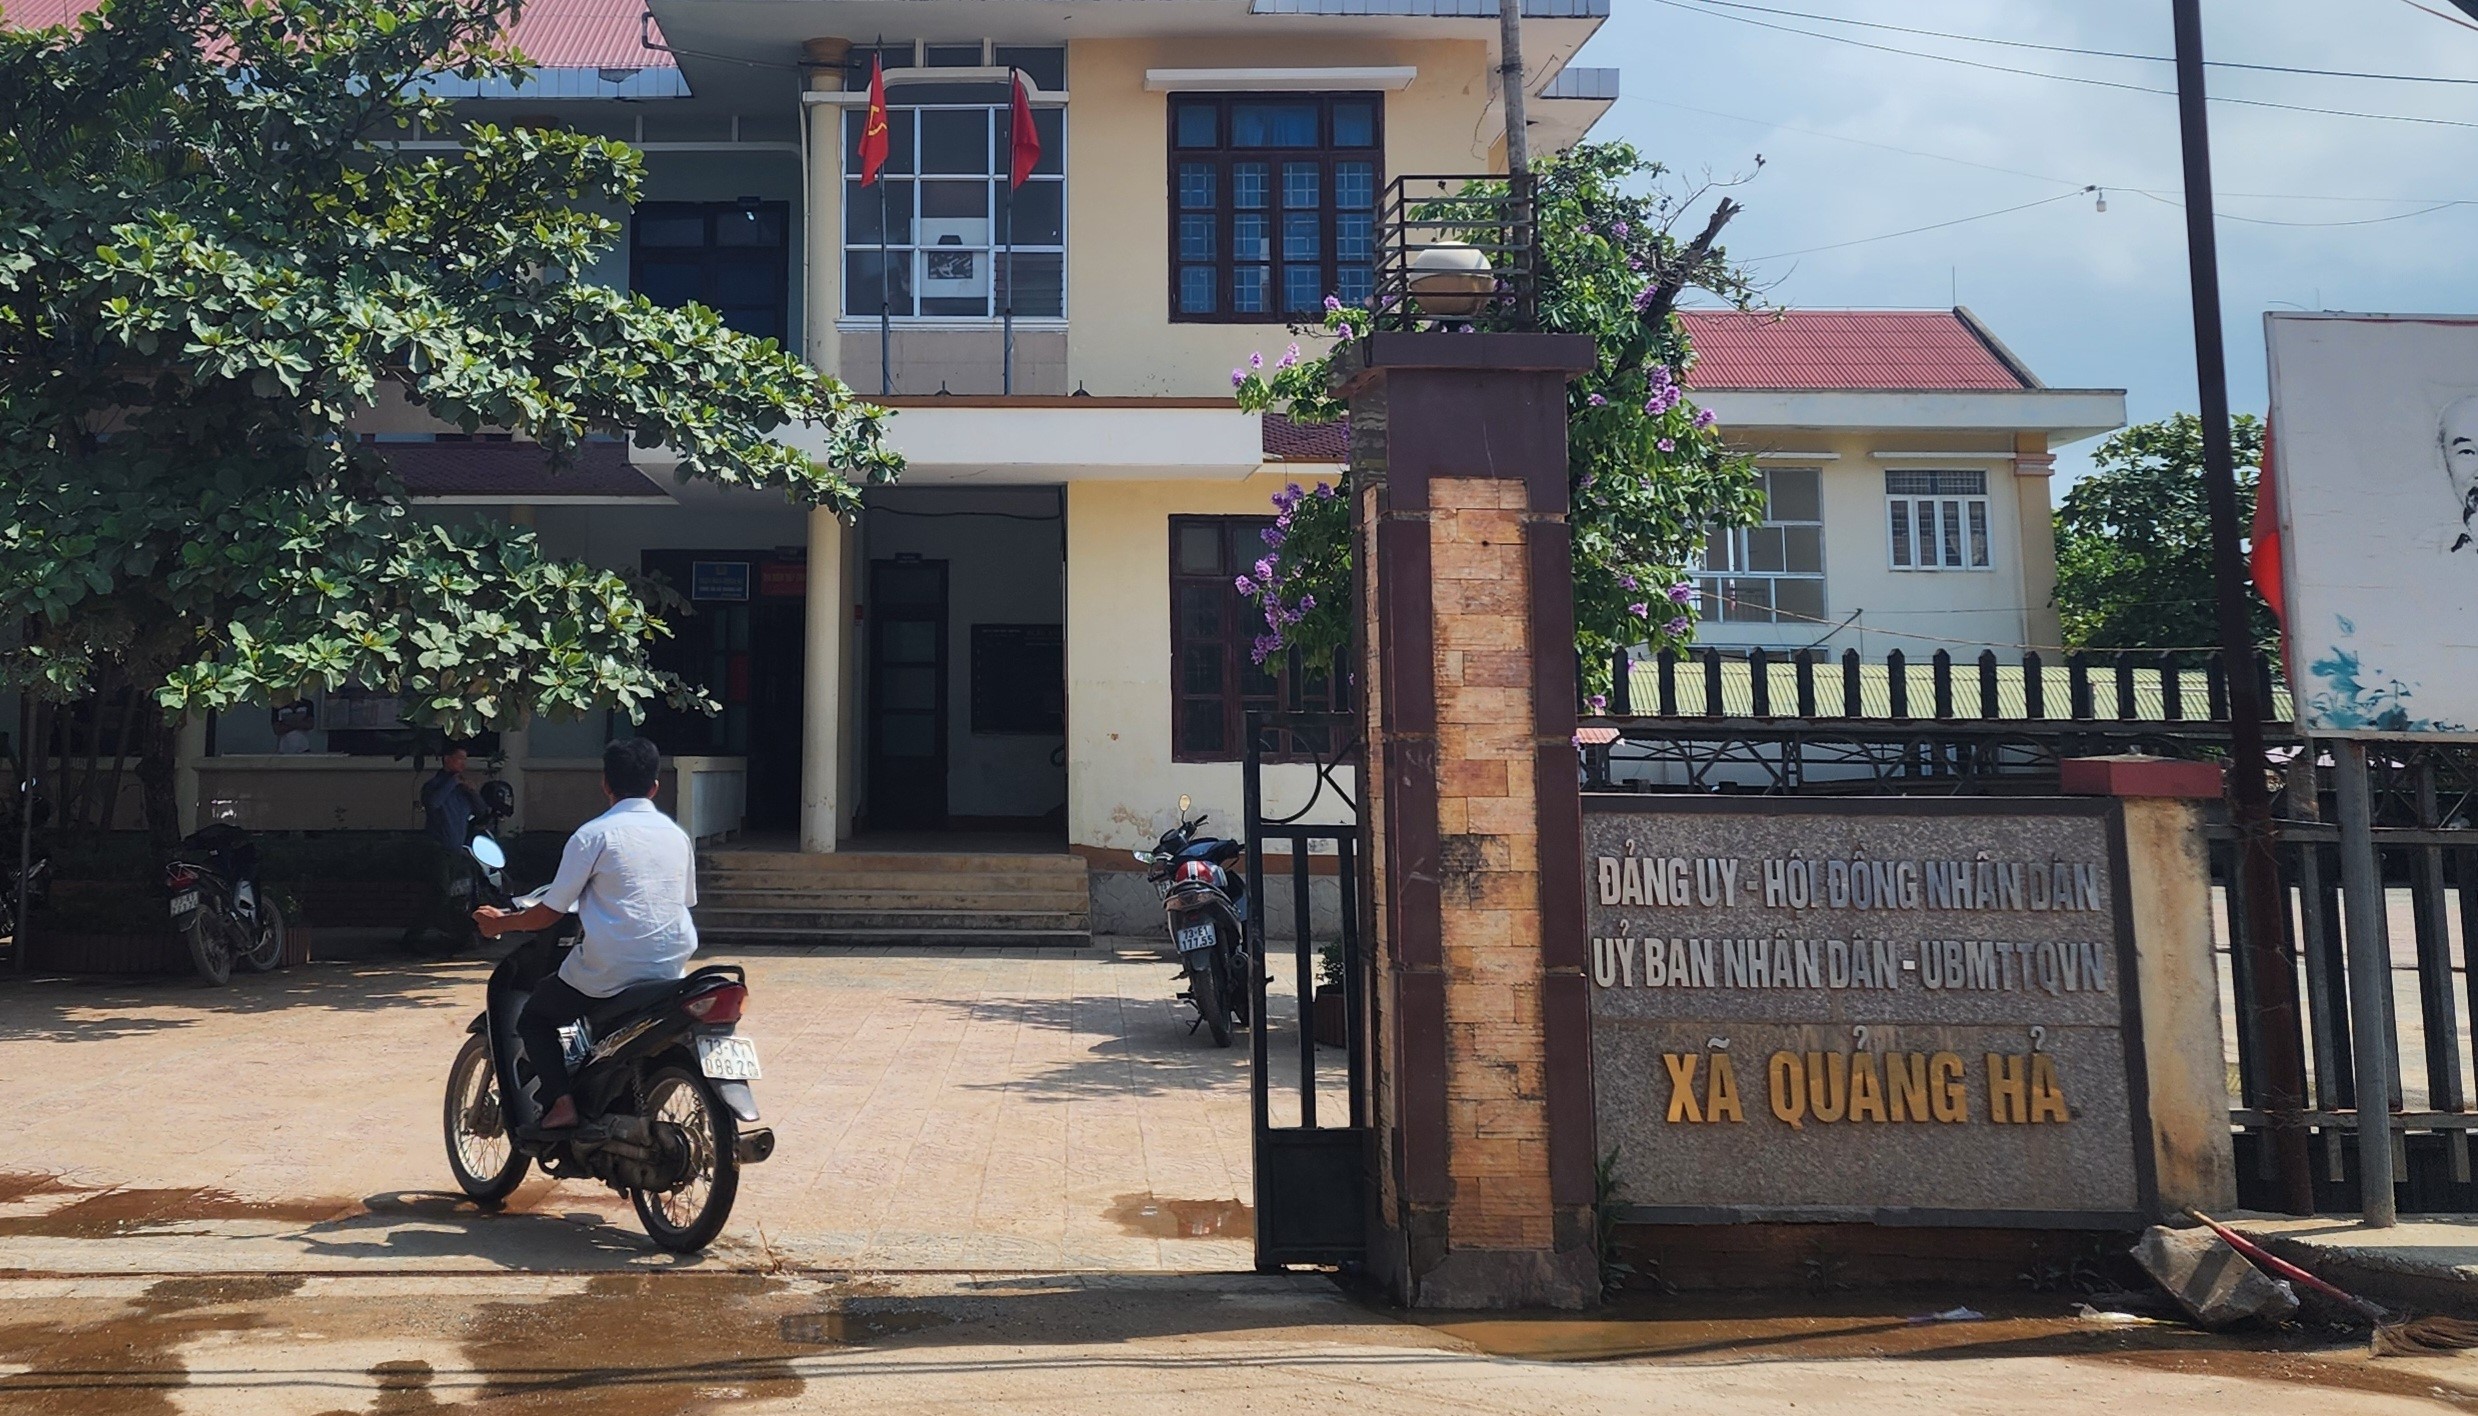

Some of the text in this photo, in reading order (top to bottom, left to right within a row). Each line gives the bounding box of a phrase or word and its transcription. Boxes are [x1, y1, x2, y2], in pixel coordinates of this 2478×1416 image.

[1598, 839, 1690, 908] ĐẢNG
[1925, 851, 2023, 911] NHÂN
[1593, 919, 1636, 988] UỶ
[1644, 938, 1715, 988] BAN
[1722, 929, 1822, 989] NHÂN
[1663, 1025, 2071, 1130] XÃ QUẢNG HẢ
